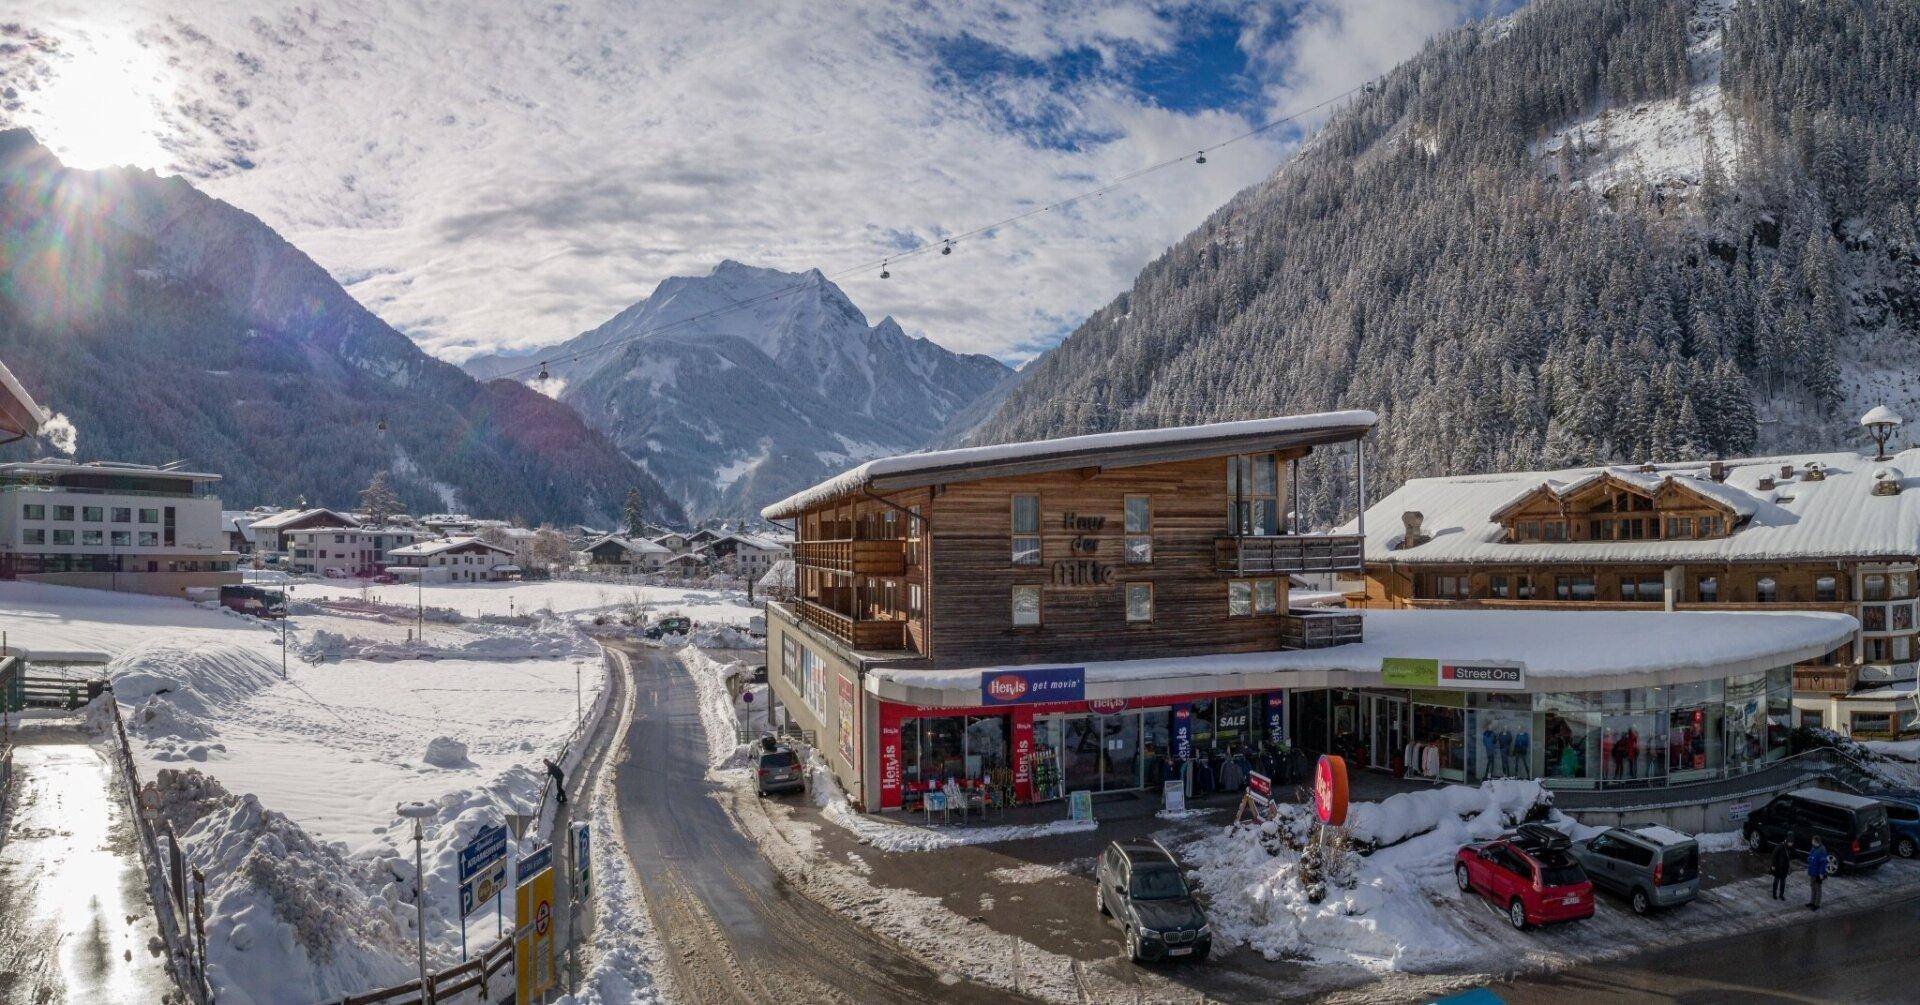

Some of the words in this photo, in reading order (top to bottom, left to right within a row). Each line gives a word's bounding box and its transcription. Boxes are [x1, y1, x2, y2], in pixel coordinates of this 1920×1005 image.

[1071, 534, 1097, 553] der
[1456, 667, 1491, 679] Street
[1493, 669, 1517, 680] One
[991, 681, 1026, 695] Hervis
[1032, 682, 1047, 692] get
[1050, 679, 1080, 689] movin'
[1094, 699, 1124, 709] Hervis
[1220, 715, 1246, 727] SALE
[1270, 714, 1281, 743] ervis
[1177, 726, 1190, 761] ervis
[882, 745, 898, 789] Hervis
[464, 890, 471, 914] P
